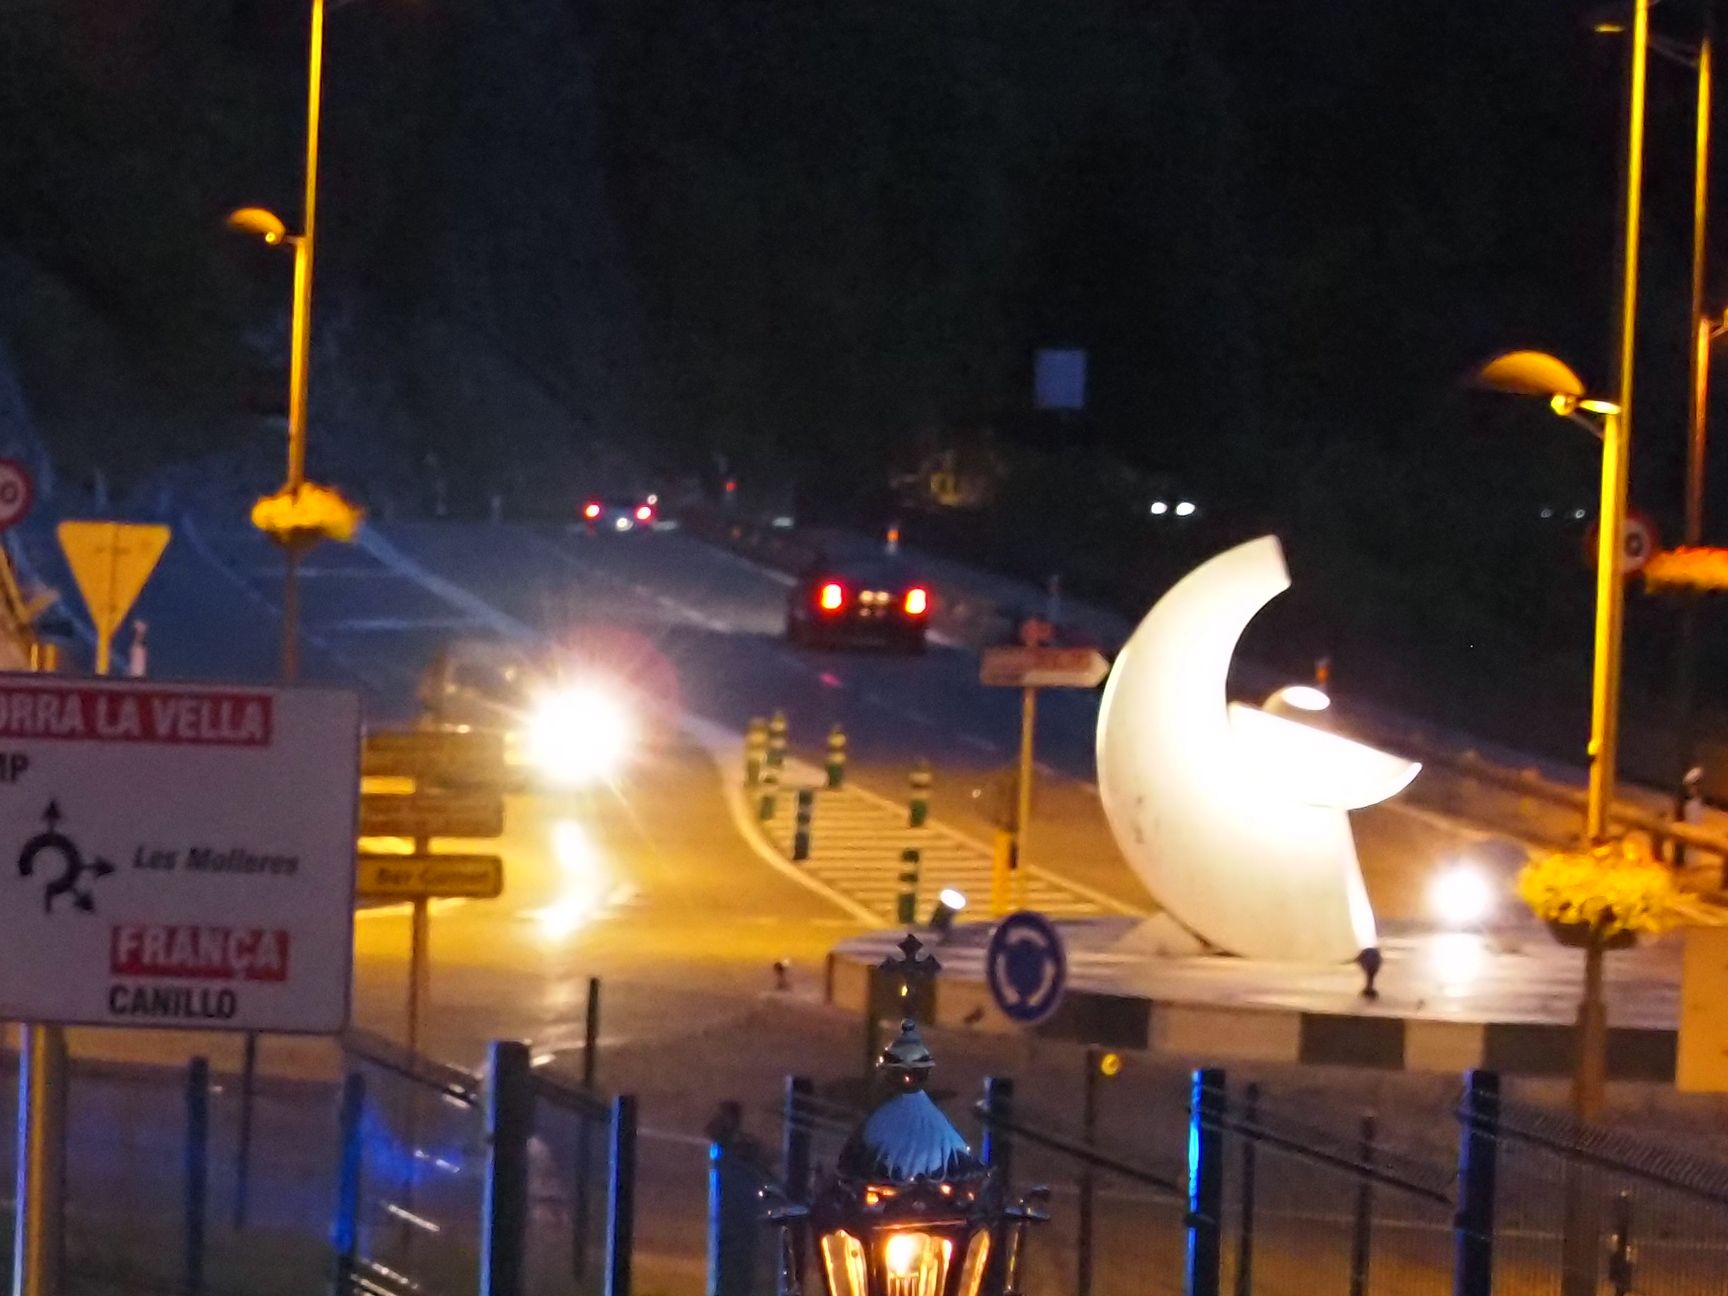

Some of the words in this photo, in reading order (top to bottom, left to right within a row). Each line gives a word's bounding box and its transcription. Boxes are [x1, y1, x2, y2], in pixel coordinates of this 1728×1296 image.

[96, 695, 143, 737] LA
[152, 699, 265, 741] VELLA
[109, 986, 237, 1019] CANILLO
